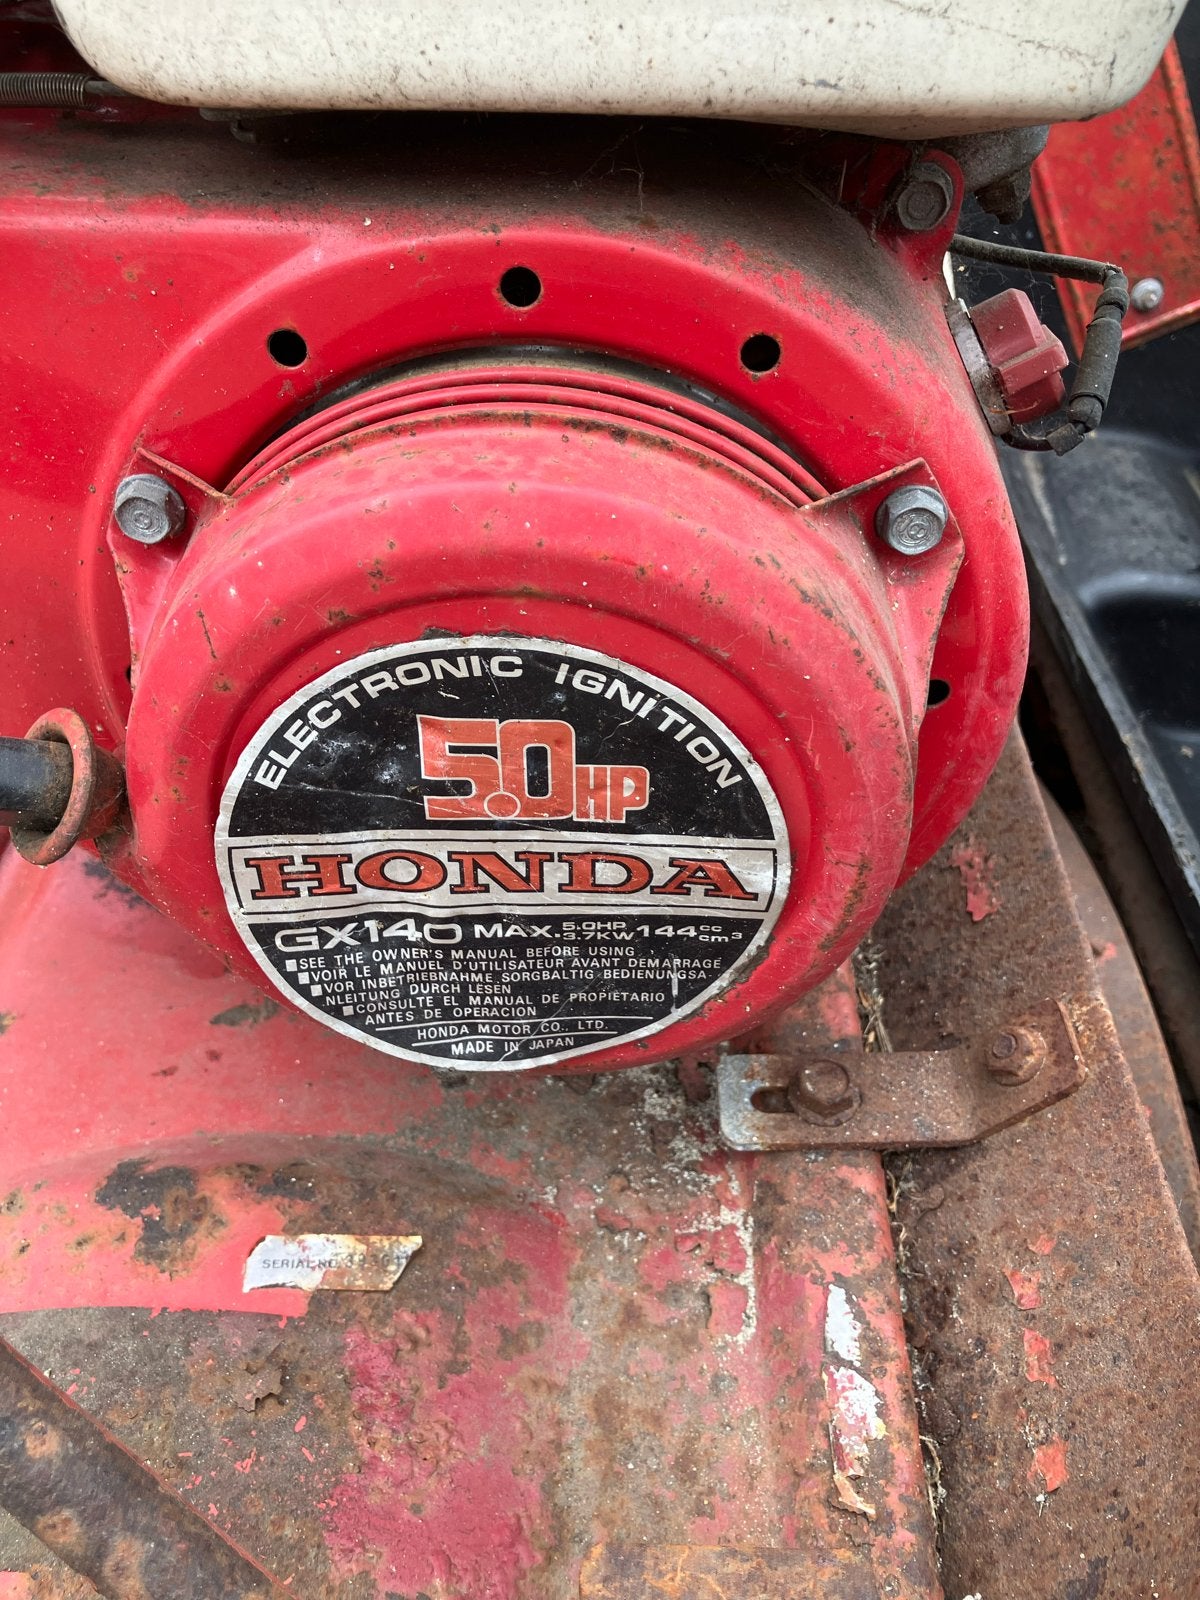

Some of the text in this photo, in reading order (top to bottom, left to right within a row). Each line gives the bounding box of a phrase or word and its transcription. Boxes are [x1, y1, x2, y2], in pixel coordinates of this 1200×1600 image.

[254, 655, 742, 790] ELECTRONIC IGNITION
[244, 849, 759, 900] HONDA
[275, 918, 462, 952] GX140
[474, 923, 561, 940] MAX.
[562, 921, 627, 931] 5.0HP
[636, 925, 697, 939] 144
[562, 931, 635, 941] 3.7KW
[300, 946, 635, 969] SEE THE OWNER'S MANUAL BEFORE USING
[311, 958, 721, 982] VOIR LE MANUEL D'UTILISATEUR AVANT DEMARRAGE
[324, 982, 355, 994] VOR
[362, 972, 494, 989] INBETRIEBNAHME
[501, 969, 595, 983] SORGBALTIG
[325, 983, 512, 1006] NLEITUNG DURCH LESEN
[357, 993, 665, 1014] CONSULTE EL MANUAL DE PROPIETARIO
[365, 1006, 537, 1025] ANTES DE OPERACION
[417, 1024, 469, 1040] HONDA
[477, 1023, 531, 1036] MOTOR
[577, 1020, 609, 1030] LTD.
[451, 1037, 575, 1056] MADE IN JAPAN
[262, 1257, 312, 1269] SERIAL
